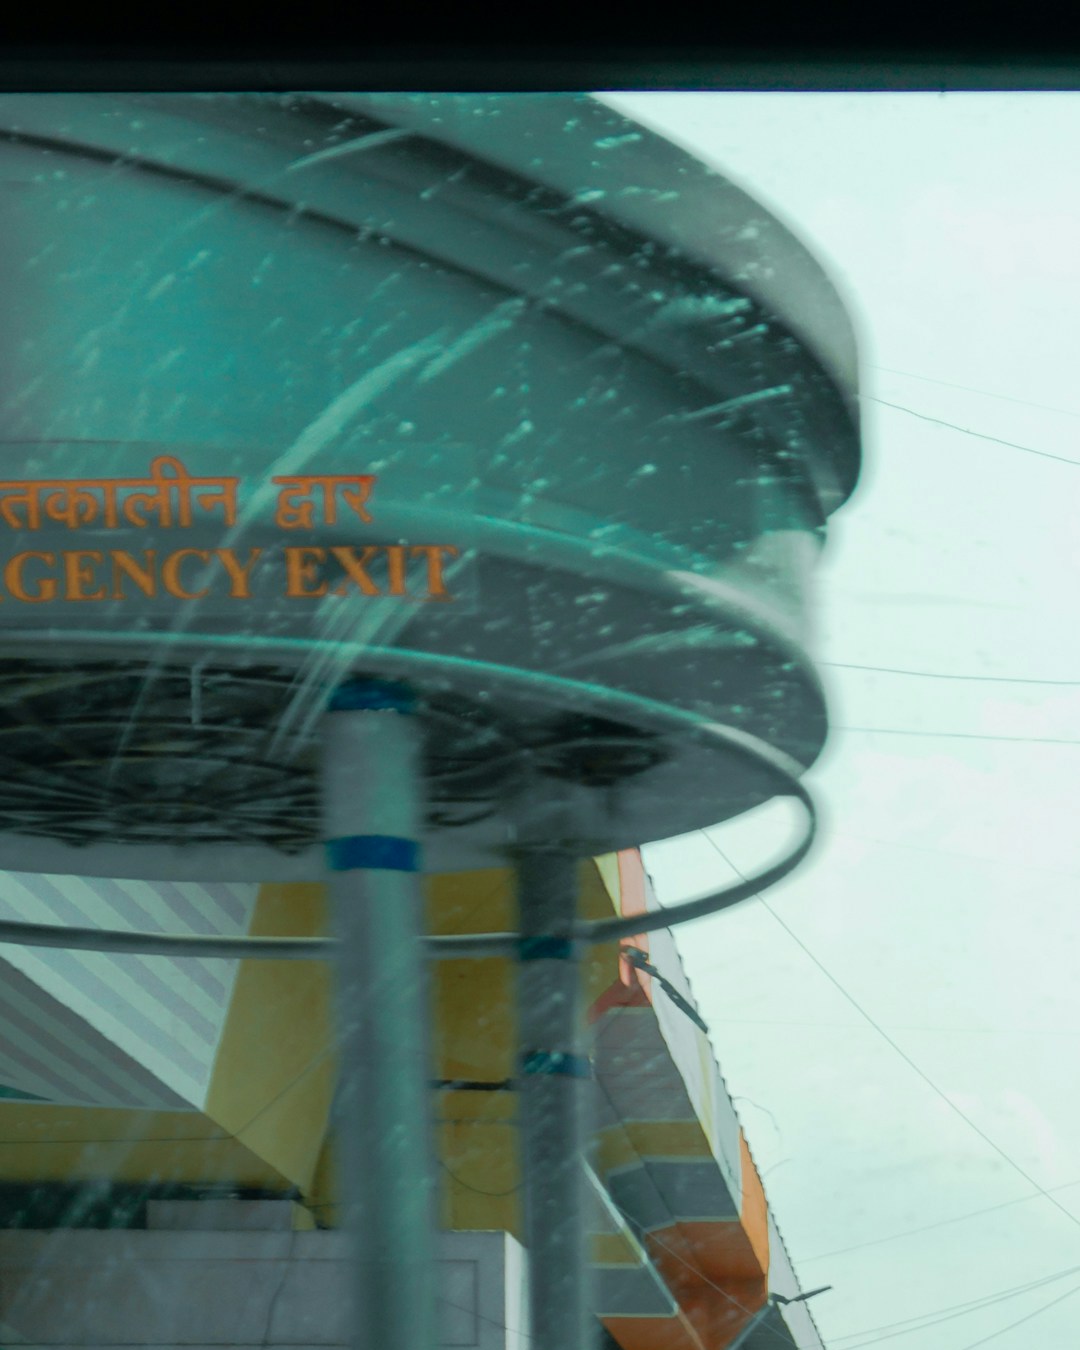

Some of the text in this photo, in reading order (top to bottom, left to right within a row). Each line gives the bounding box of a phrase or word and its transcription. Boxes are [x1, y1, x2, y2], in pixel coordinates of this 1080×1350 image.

[271, 474, 377, 530] द्वार
[0, 545, 460, 603] GENCY EXIT
